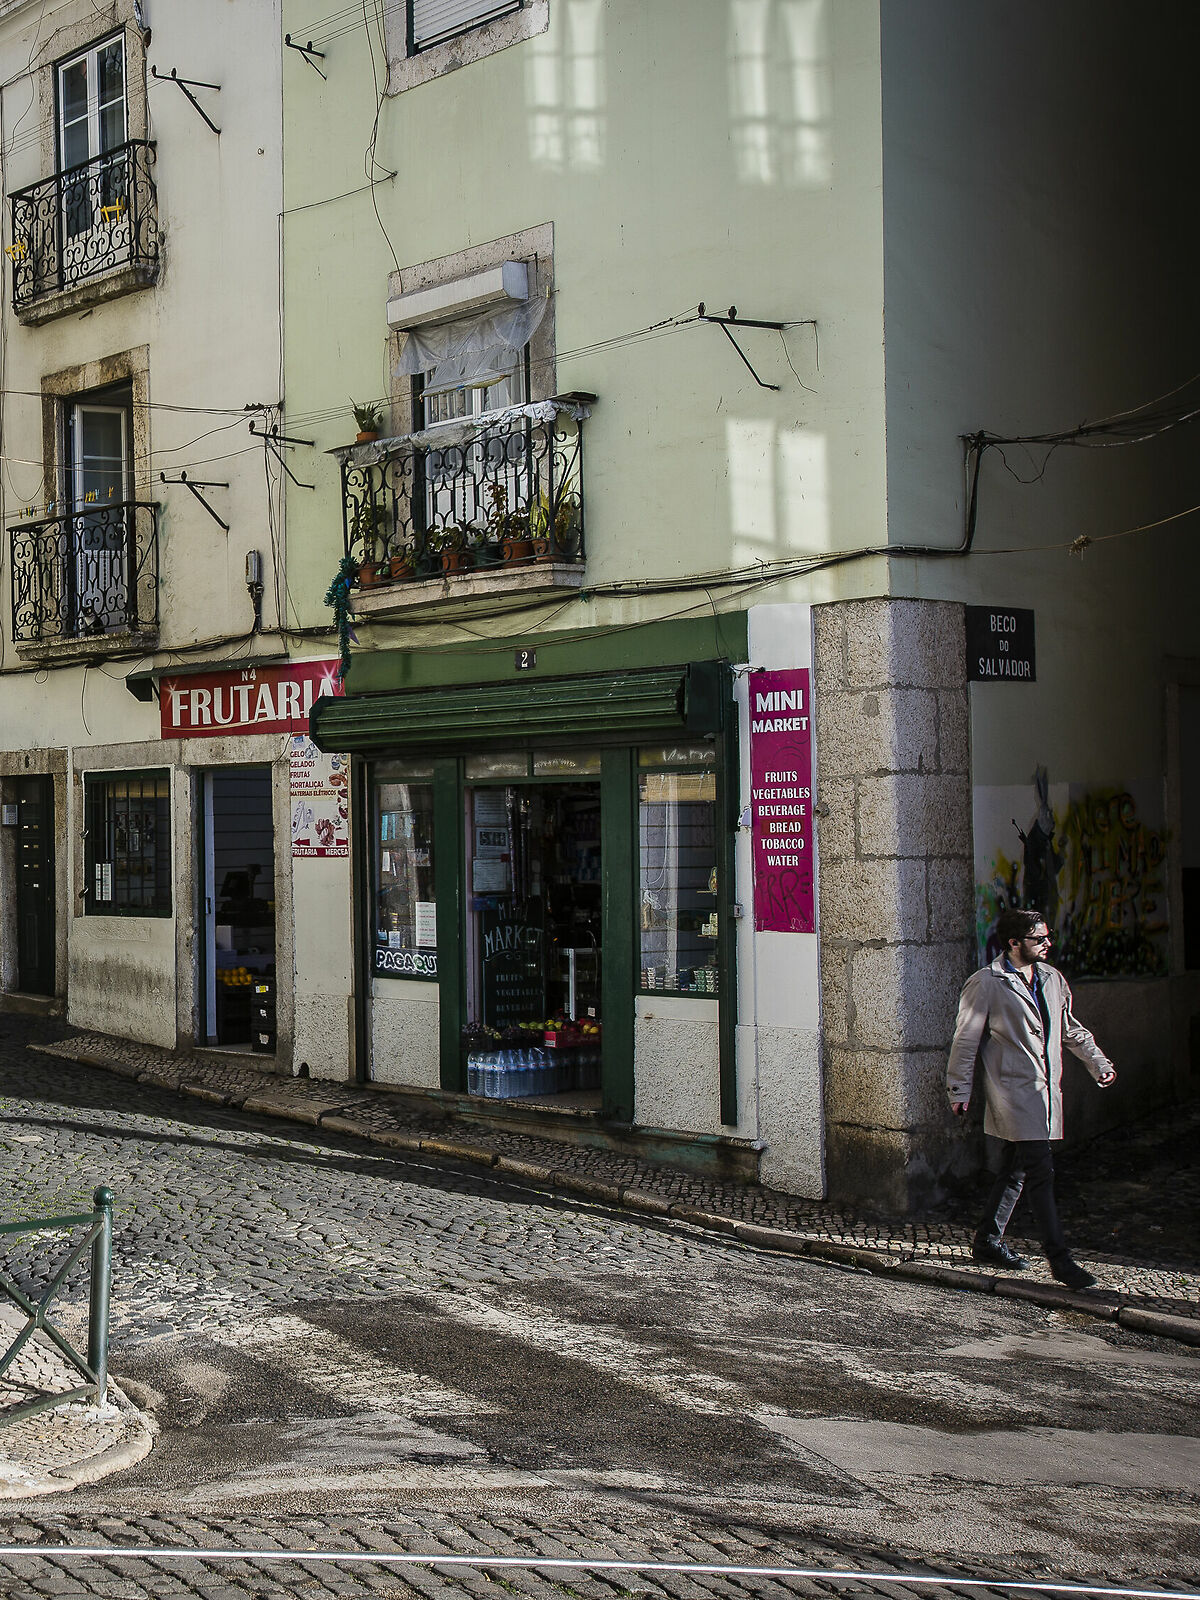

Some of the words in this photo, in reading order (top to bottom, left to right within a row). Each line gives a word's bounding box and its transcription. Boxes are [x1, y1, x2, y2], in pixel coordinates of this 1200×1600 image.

[990, 614, 1017, 633] BECO
[999, 640, 1009, 652] DO
[521, 651, 528, 668] 2
[978, 657, 1031, 677] SALVADOR
[756, 689, 803, 713] MINI
[752, 716, 808, 733] MARKET
[290, 750, 305, 758] GELO
[290, 760, 316, 768] GELADOS
[290, 771, 311, 779] FRUTAS
[764, 771, 798, 783] FRUITS
[290, 780, 324, 789] HORTALIÇAS
[752, 787, 810, 800] VEGETABLES
[758, 804, 806, 816] BEVERAGE
[769, 821, 801, 833] BREAD
[760, 838, 805, 850] TOBACCO
[291, 848, 318, 856] FRUTARIA
[767, 855, 799, 867] WATER
